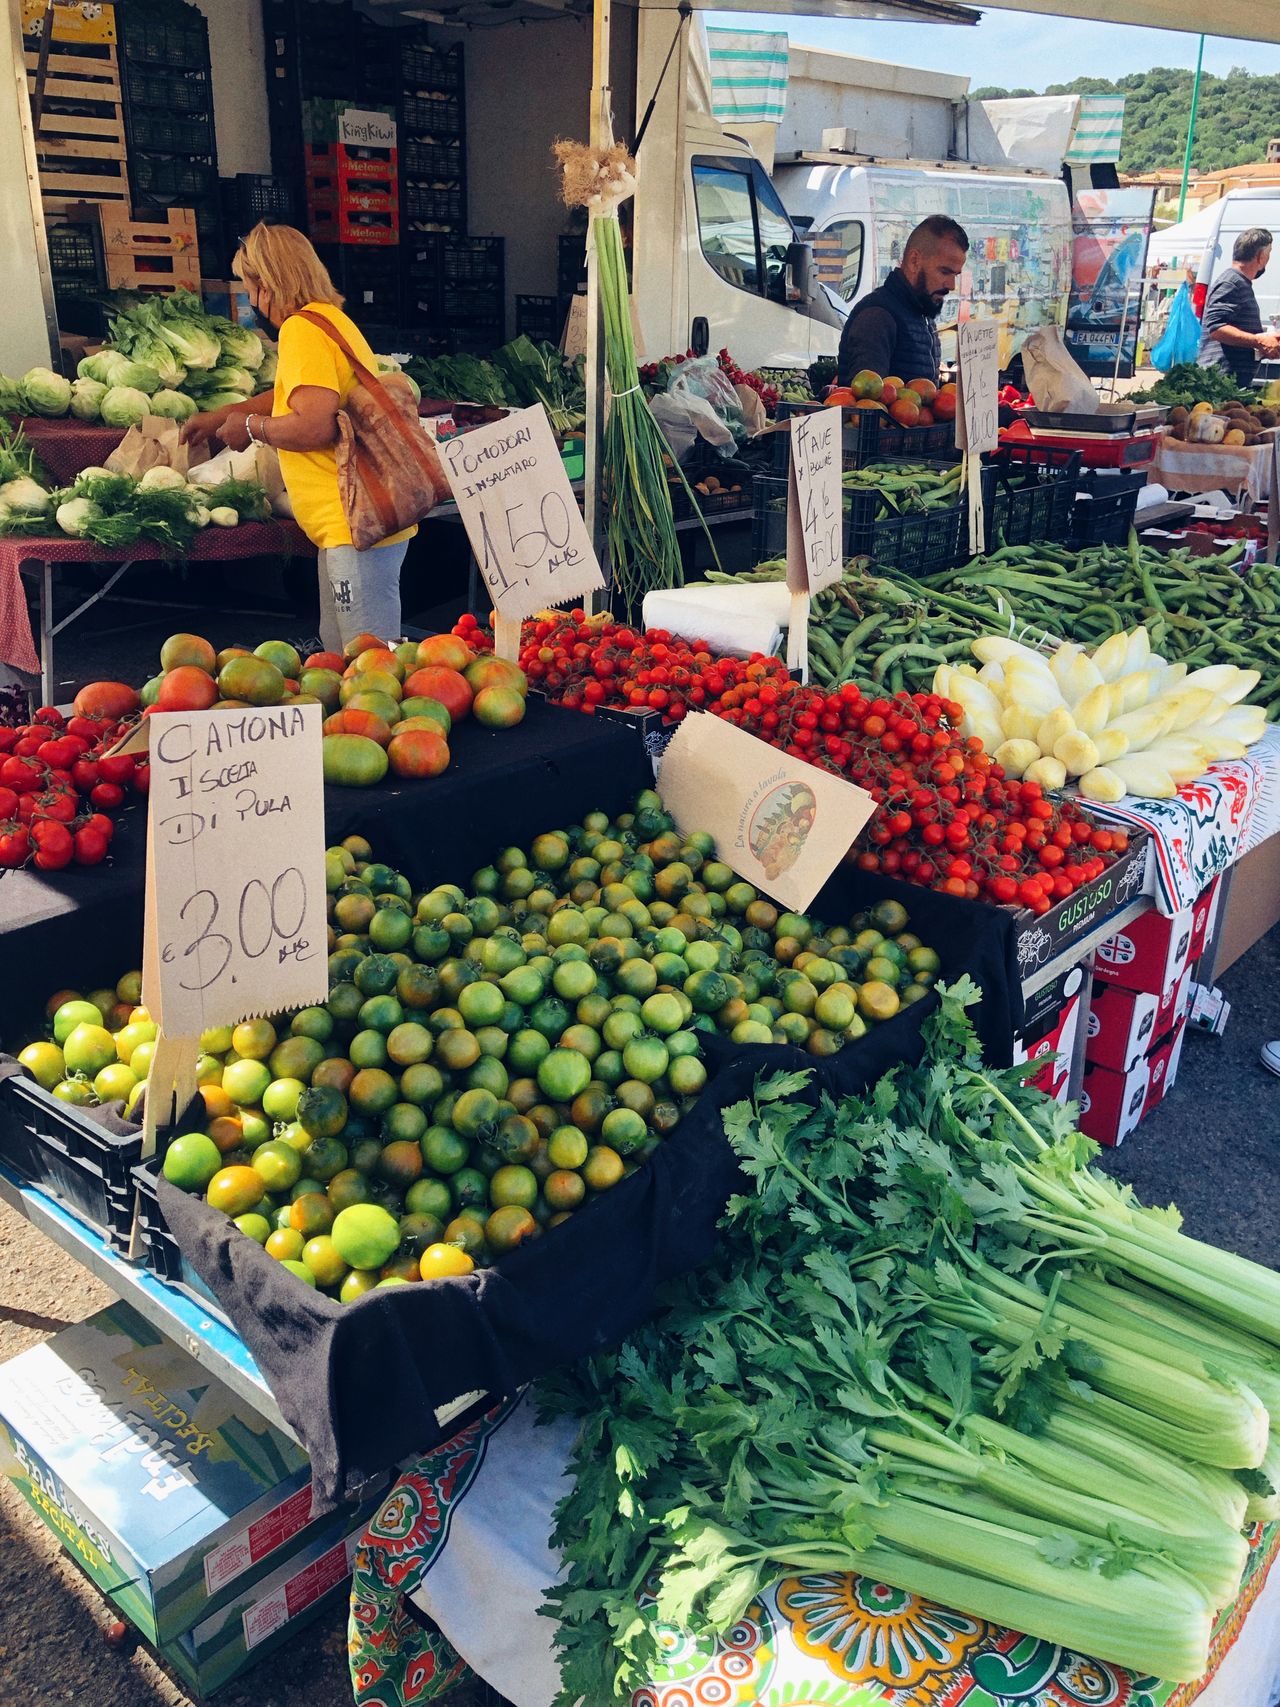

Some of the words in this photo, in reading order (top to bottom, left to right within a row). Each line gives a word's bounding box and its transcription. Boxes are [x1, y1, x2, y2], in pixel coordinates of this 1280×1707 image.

[348, 160, 387, 172] Melone
[350, 227, 388, 238] Melone
[966, 364, 977, 408] 4
[445, 426, 532, 477] POMODORI
[795, 415, 832, 458] FAVE
[805, 488, 819, 535] 4
[333, 579, 351, 604] uff
[157, 707, 305, 764] CAMONA
[199, 760, 259, 793] SCELTA
[235, 788, 293, 822] PULA
[738, 797, 754, 833] natura
[758, 767, 787, 792] tavola
[1058, 879, 1112, 932] GUSTOSO
[1072, 910, 1096, 934] PREMIUM
[120, 1367, 216, 1455] RECITAL
[14, 1437, 113, 1565] Endives
[30, 1482, 98, 1570] RECITAL
